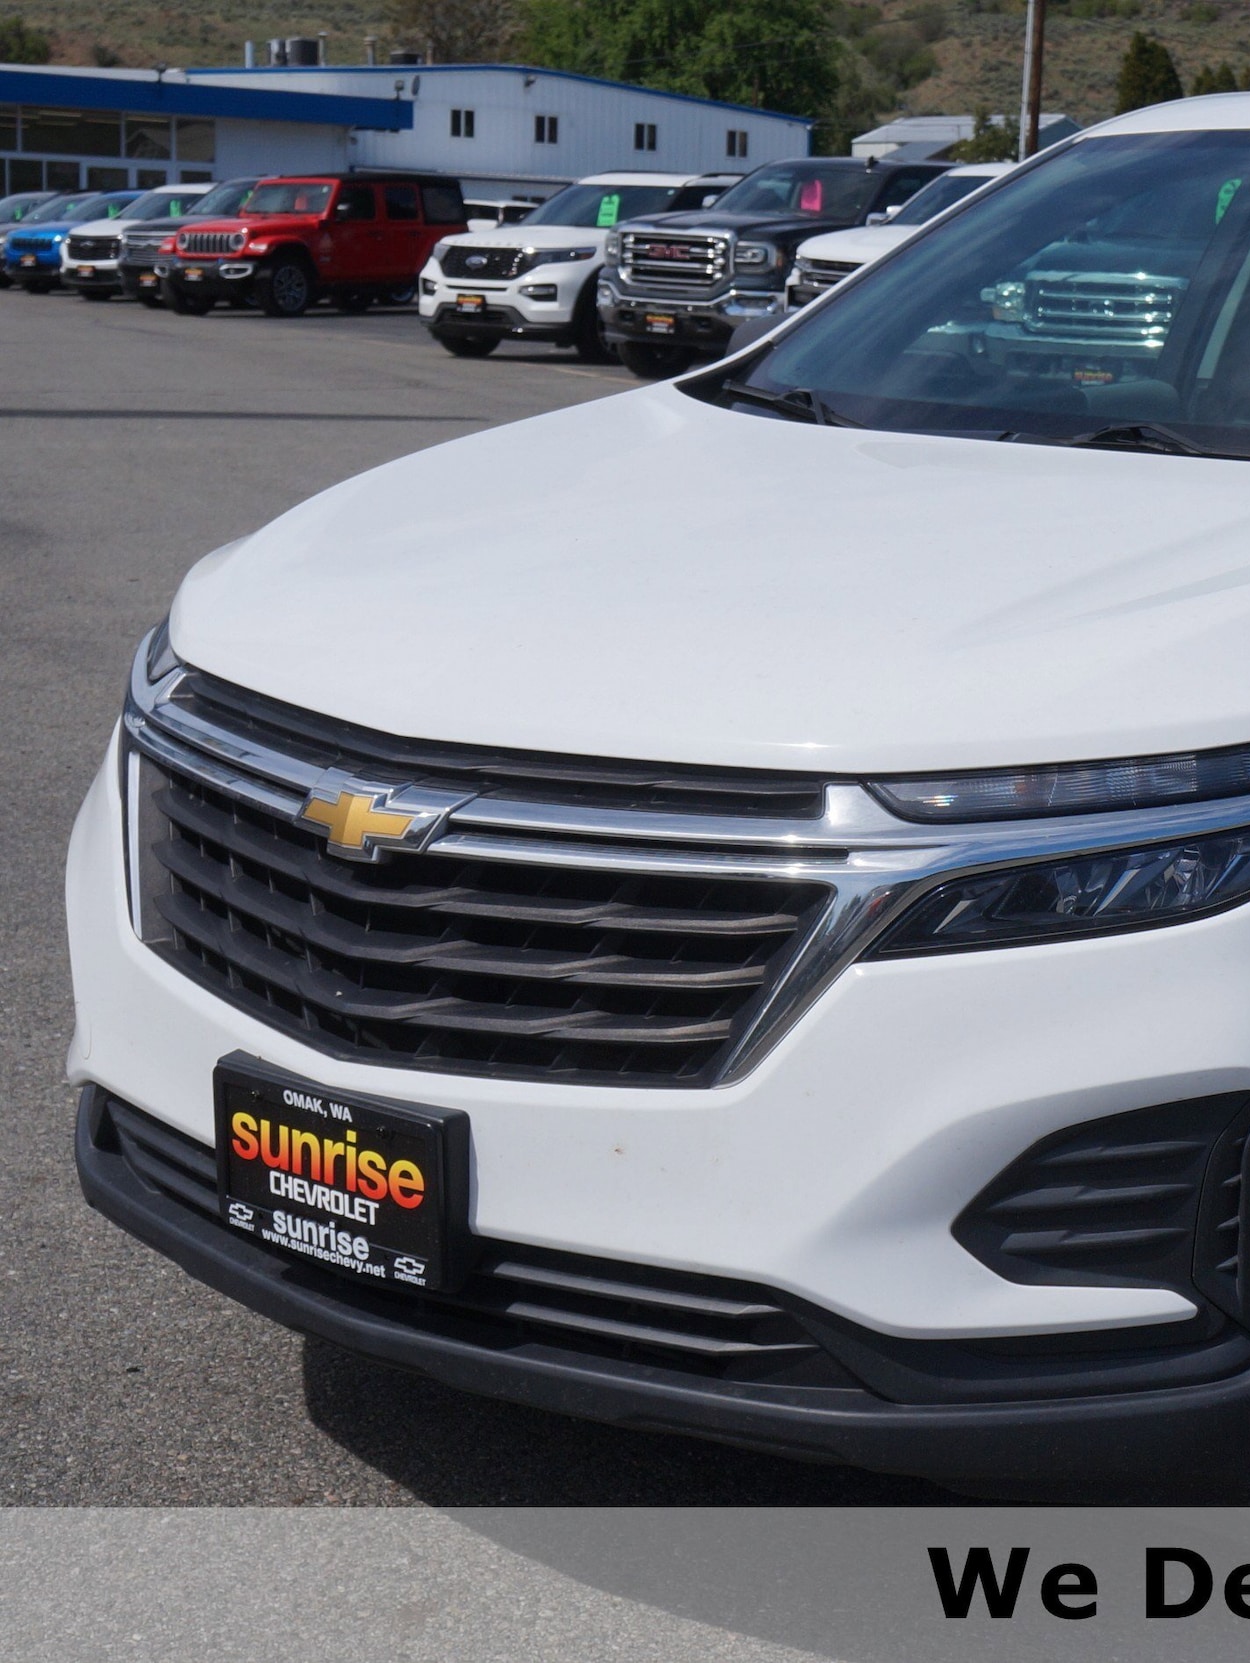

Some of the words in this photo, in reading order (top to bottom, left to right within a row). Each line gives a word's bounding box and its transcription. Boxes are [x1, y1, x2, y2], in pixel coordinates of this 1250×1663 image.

[283, 1089, 327, 1118] OMAK,
[329, 1103, 353, 1123] WA
[232, 1111, 425, 1209] sunrise
[269, 1170, 379, 1225] CHEVROLET
[261, 1228, 386, 1278] www.sunrisechevy.net
[273, 1210, 370, 1260] sunrise
